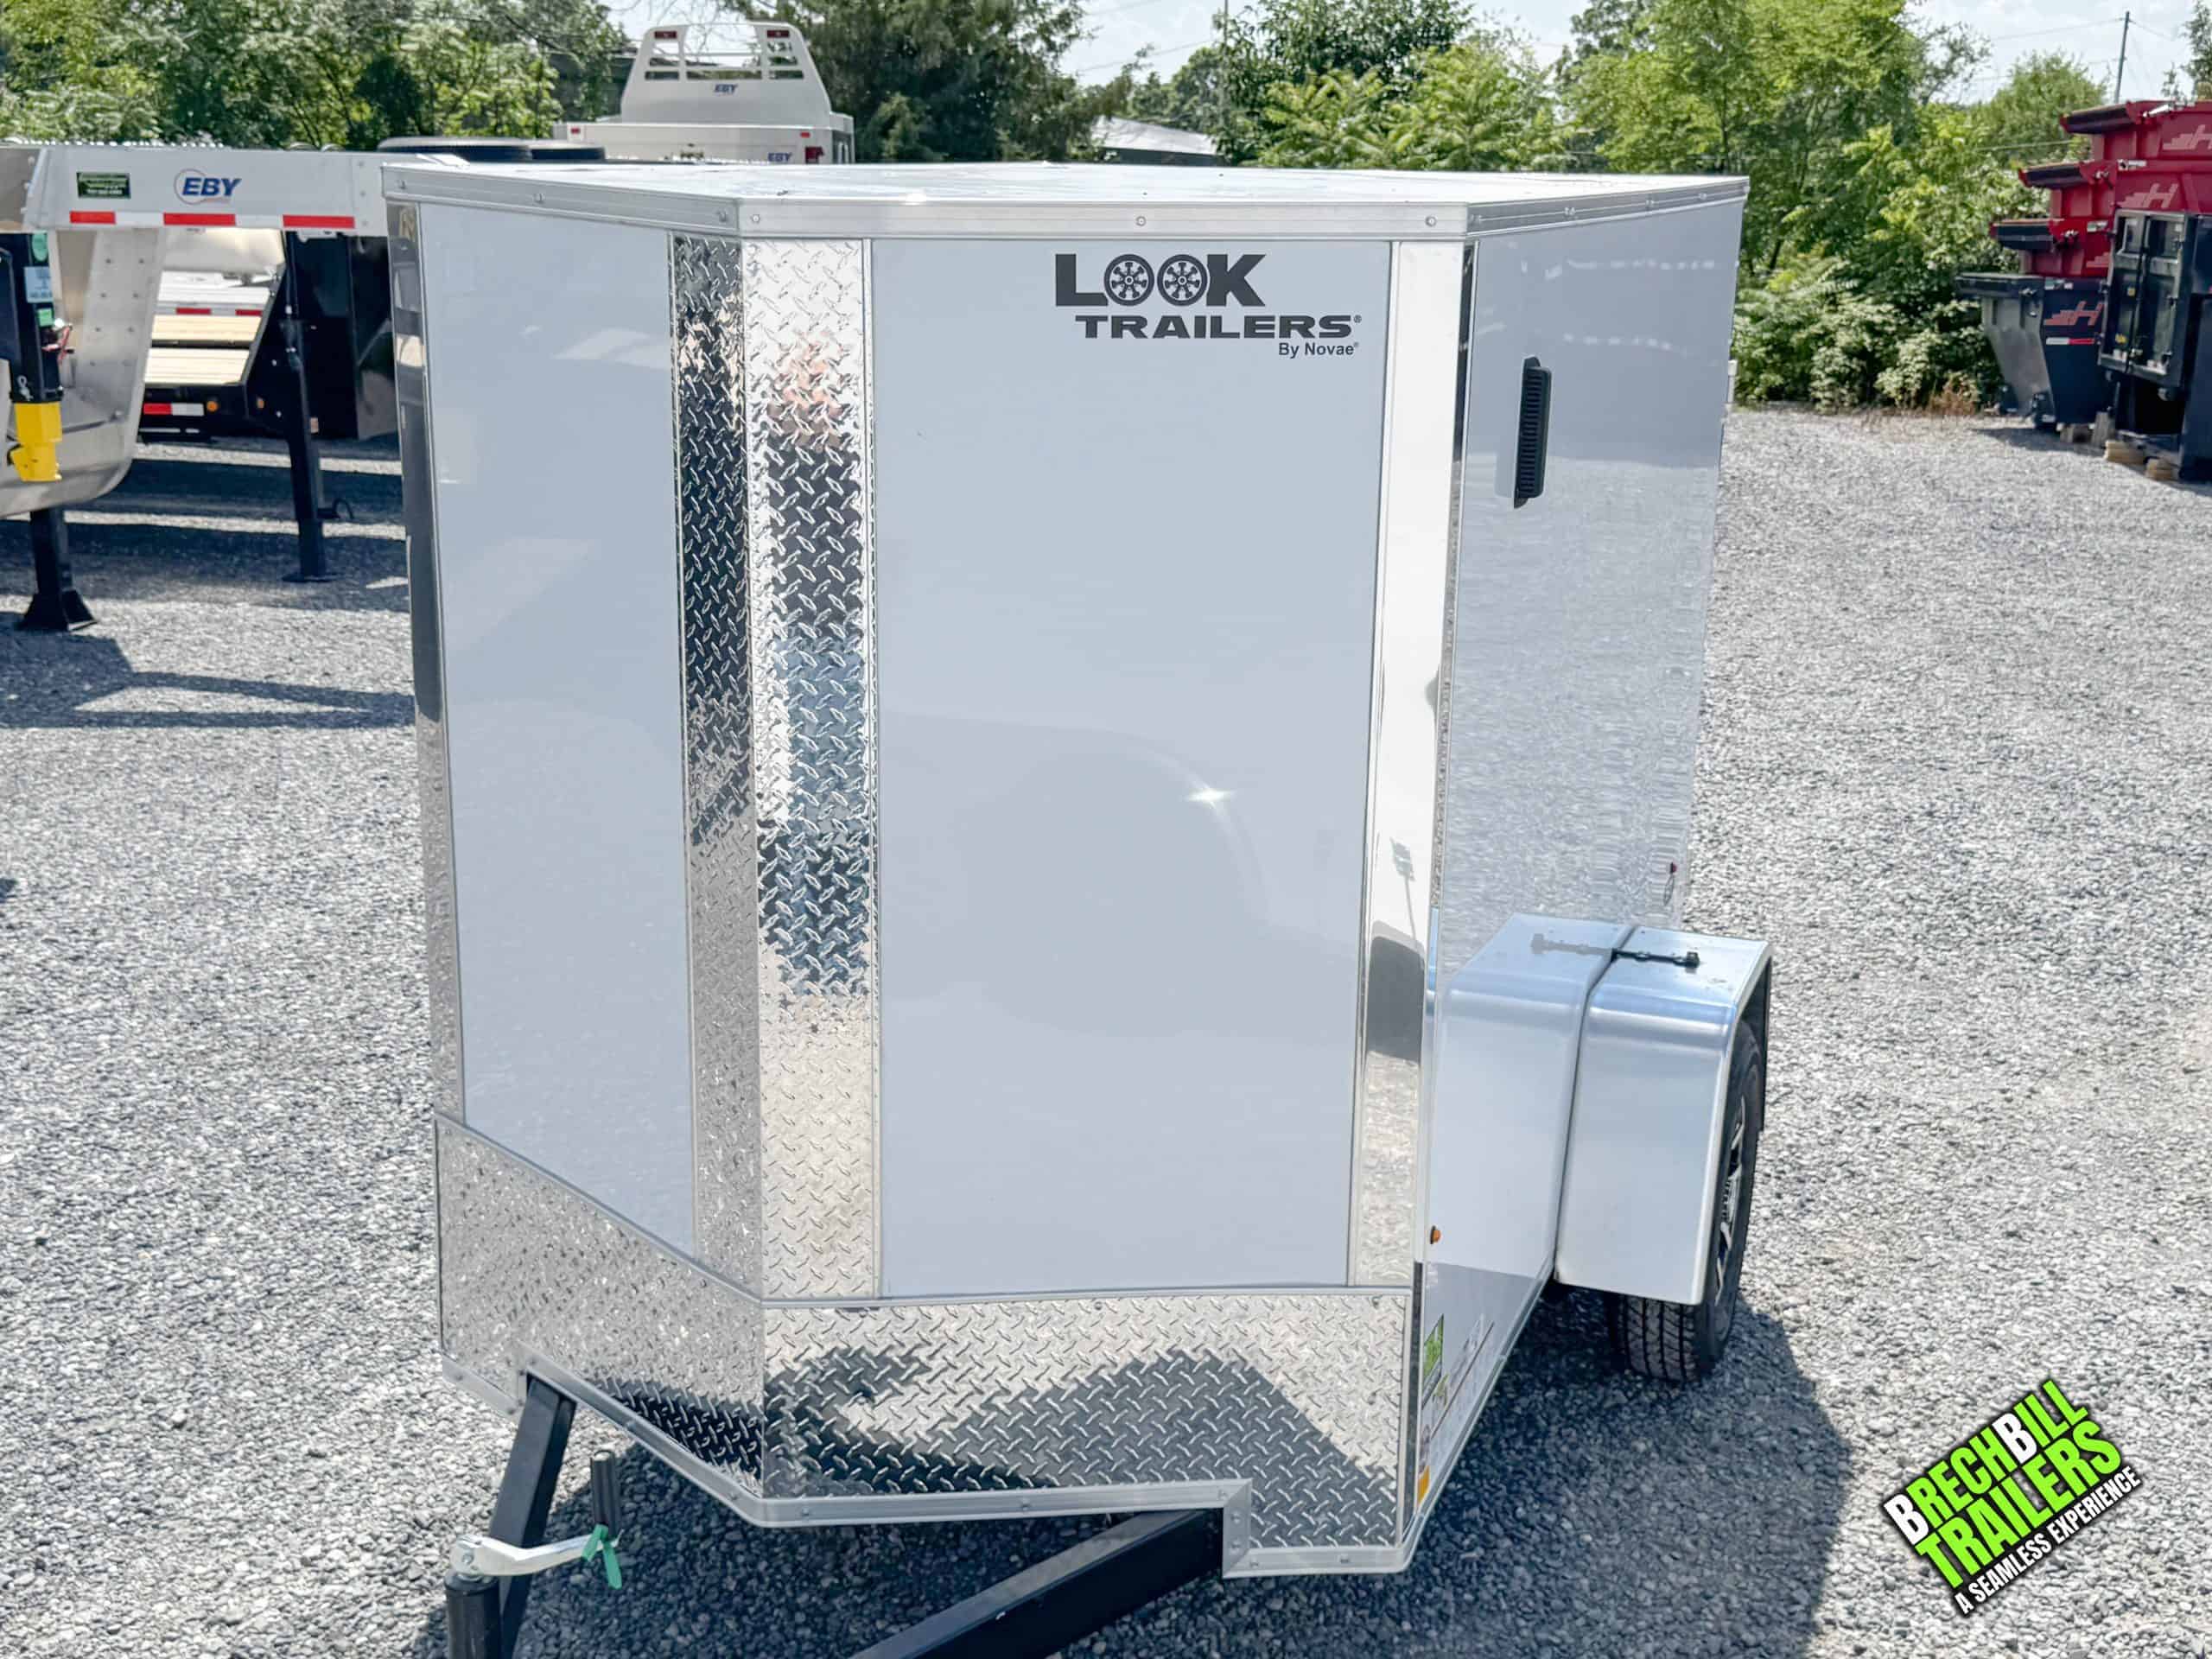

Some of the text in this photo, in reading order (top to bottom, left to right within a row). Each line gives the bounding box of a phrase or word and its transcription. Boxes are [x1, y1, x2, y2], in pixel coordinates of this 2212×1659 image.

[182, 178, 242, 196] EBY
[1055, 253, 1267, 307] LOOK
[1279, 342, 1300, 359] By
